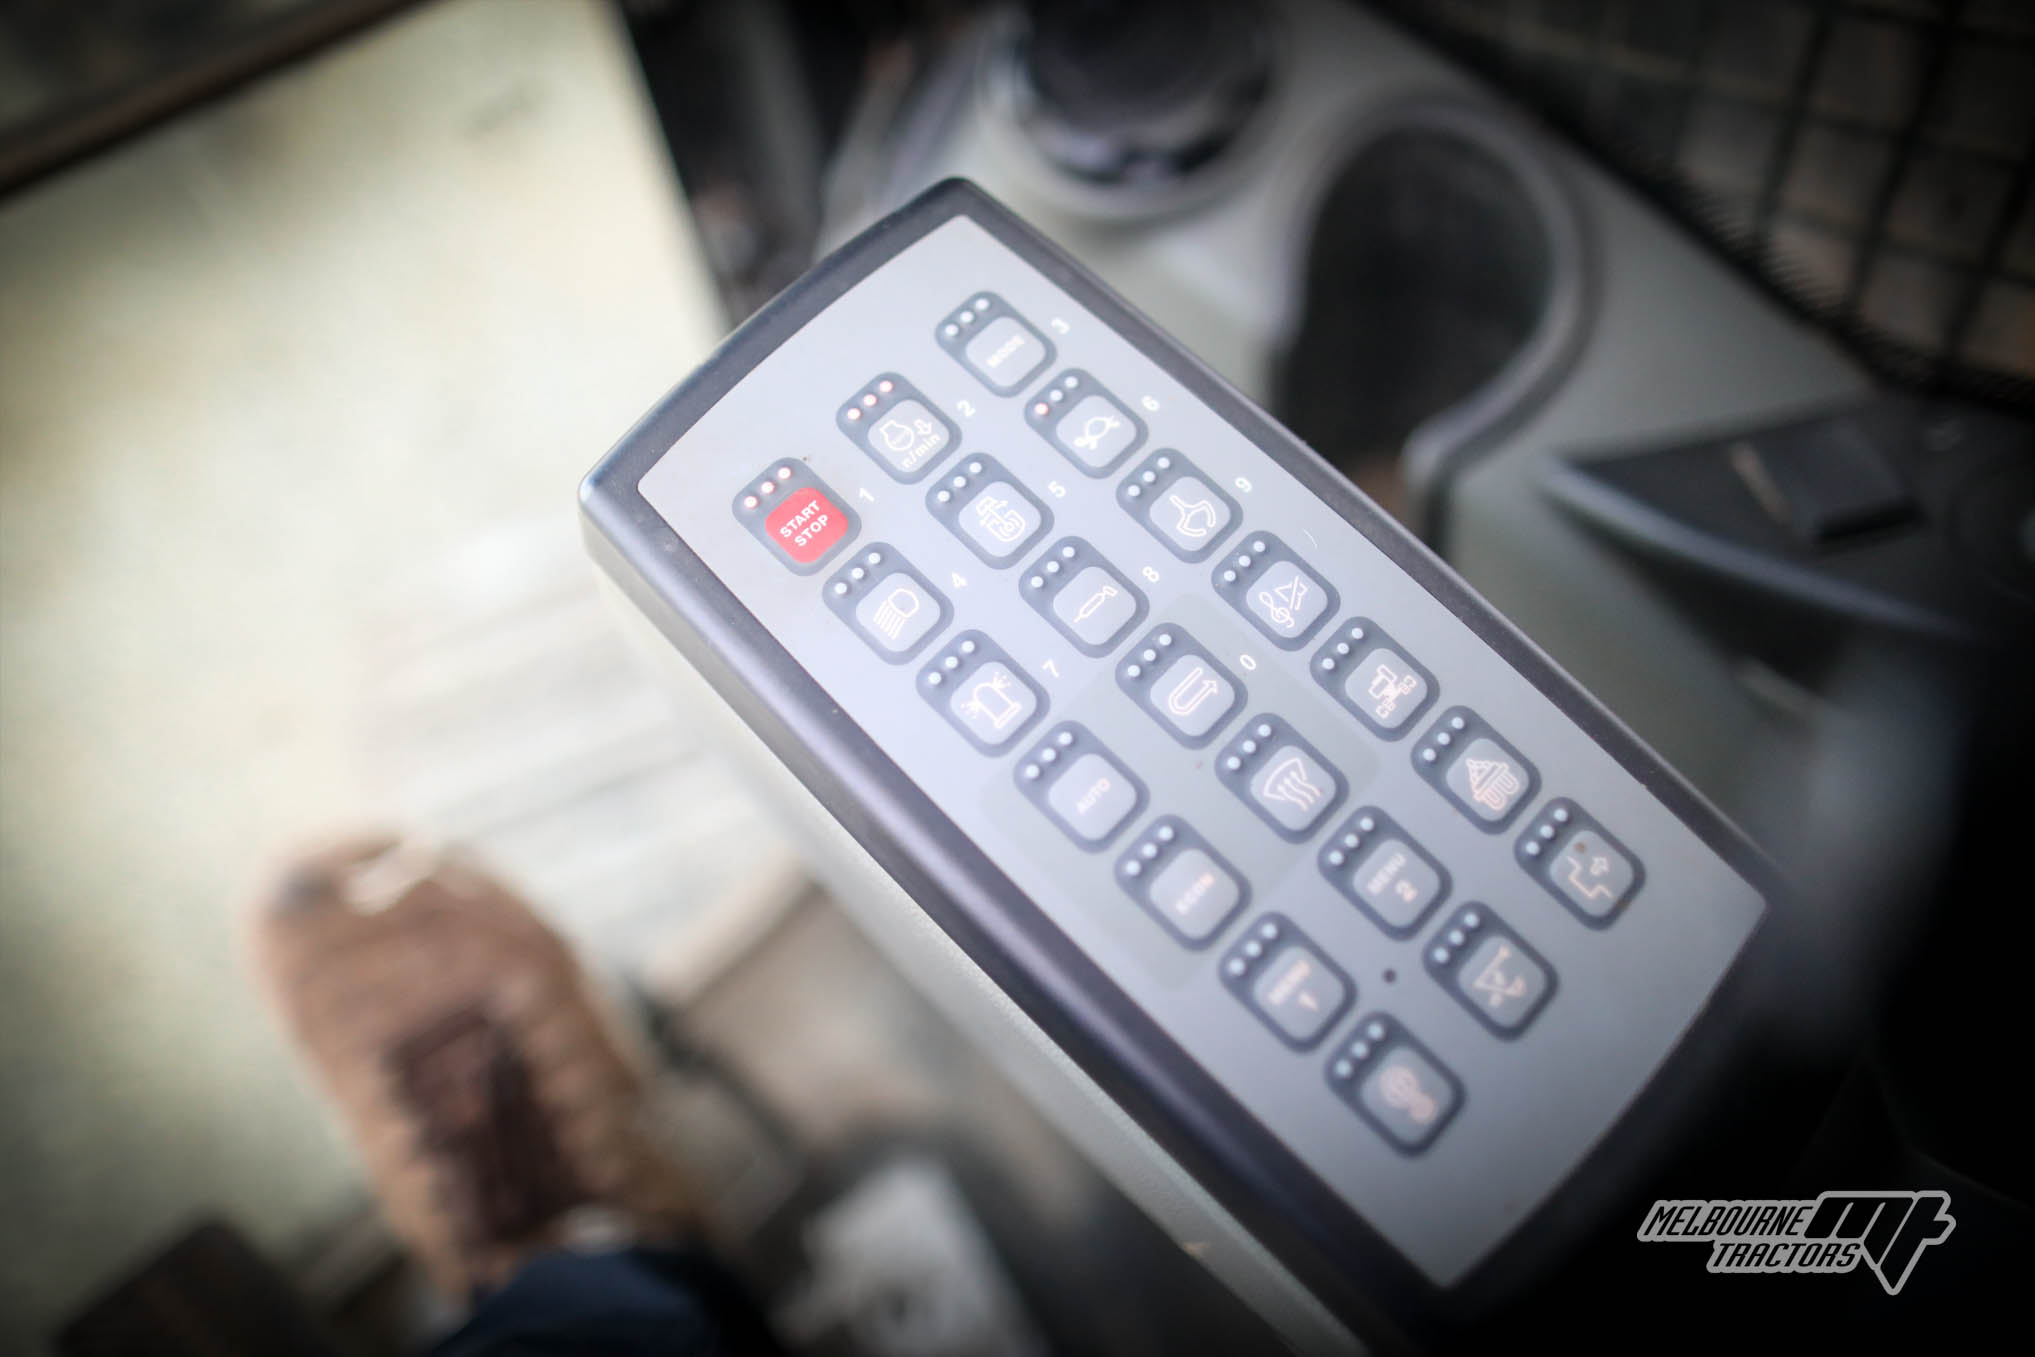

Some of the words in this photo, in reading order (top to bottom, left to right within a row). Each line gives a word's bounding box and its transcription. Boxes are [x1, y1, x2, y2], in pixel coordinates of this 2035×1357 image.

[1051, 317, 1070, 335] 3
[956, 399, 976, 418] 2
[1141, 395, 1160, 412] 6
[1047, 480, 1067, 499] 5
[1234, 476, 1253, 493] 9
[857, 487, 875, 503] 1
[779, 499, 821, 538] START
[793, 513, 829, 547] STOP
[951, 571, 968, 588] 4
[1141, 565, 1160, 583] 8
[1042, 658, 1060, 678] 7
